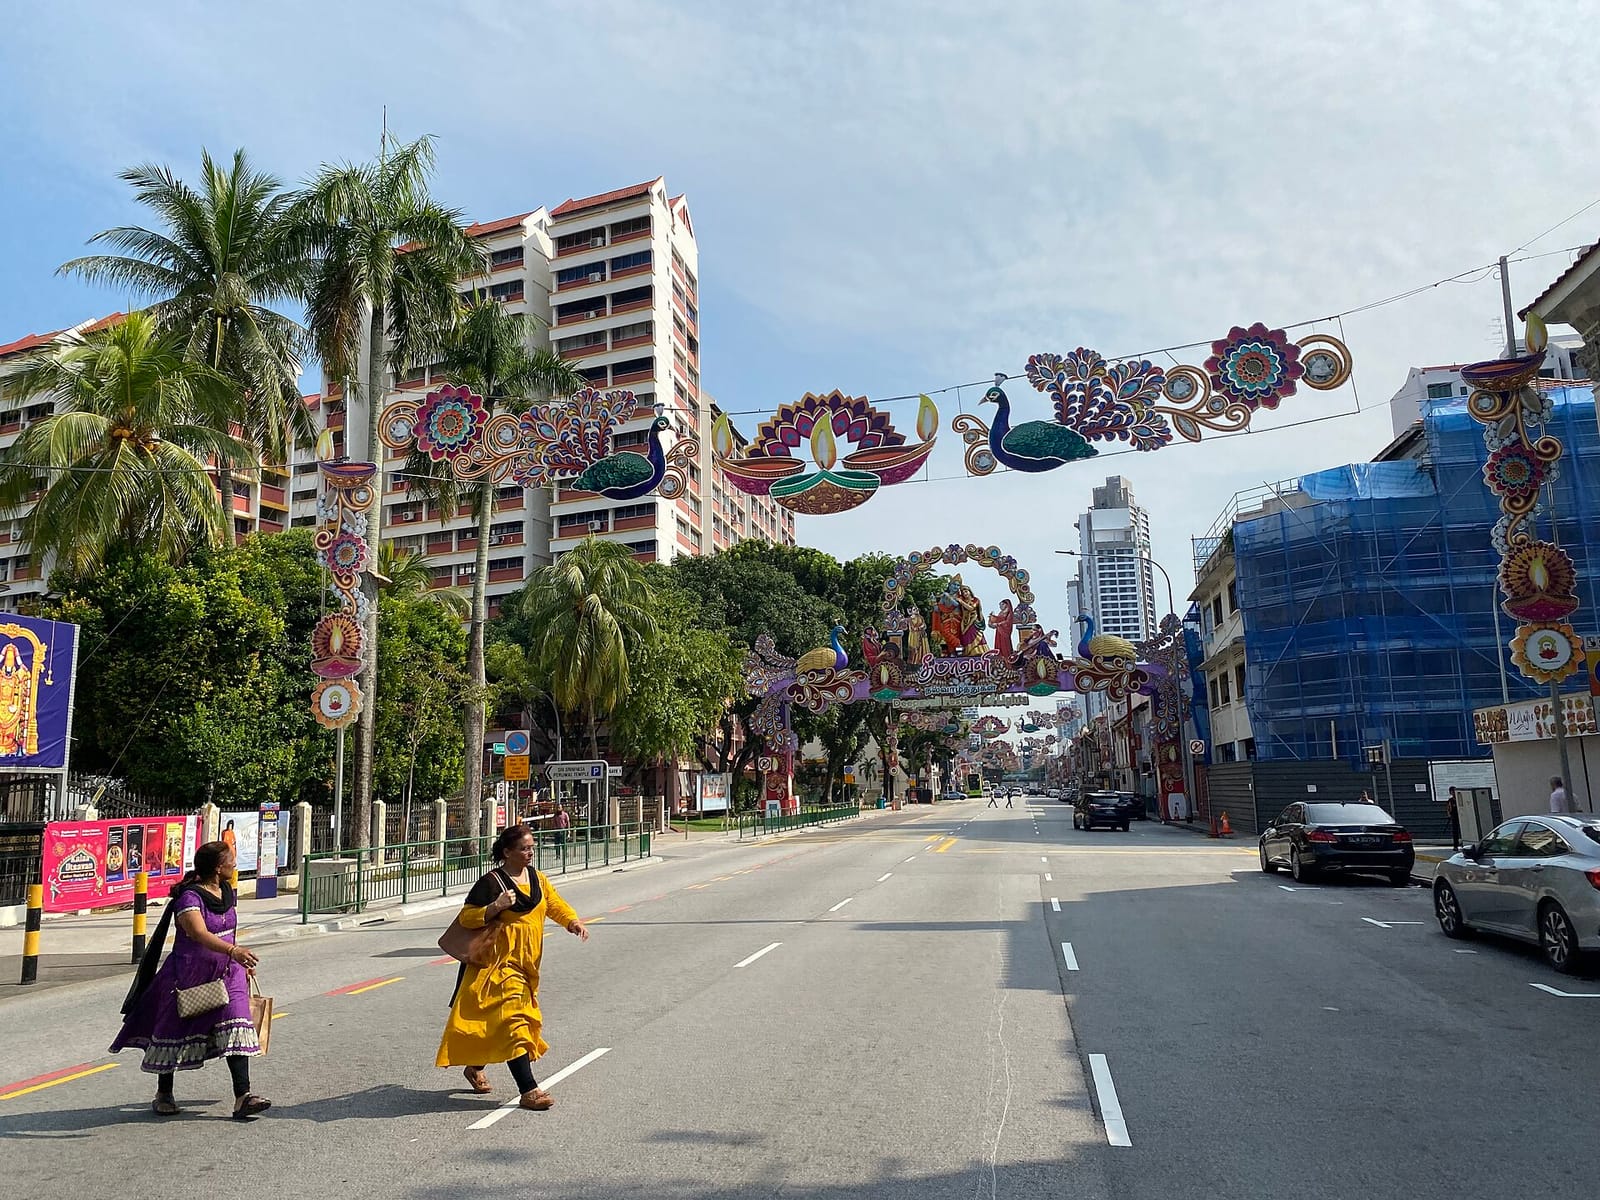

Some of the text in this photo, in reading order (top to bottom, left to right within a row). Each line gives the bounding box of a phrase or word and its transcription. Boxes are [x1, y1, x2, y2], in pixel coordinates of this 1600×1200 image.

[918, 649, 1000, 684] தீபாவளி
[893, 697, 942, 710] Deepavali
[943, 694, 982, 707] Festival
[997, 693, 1029, 708] Lights
[593, 767, 600, 776] P
